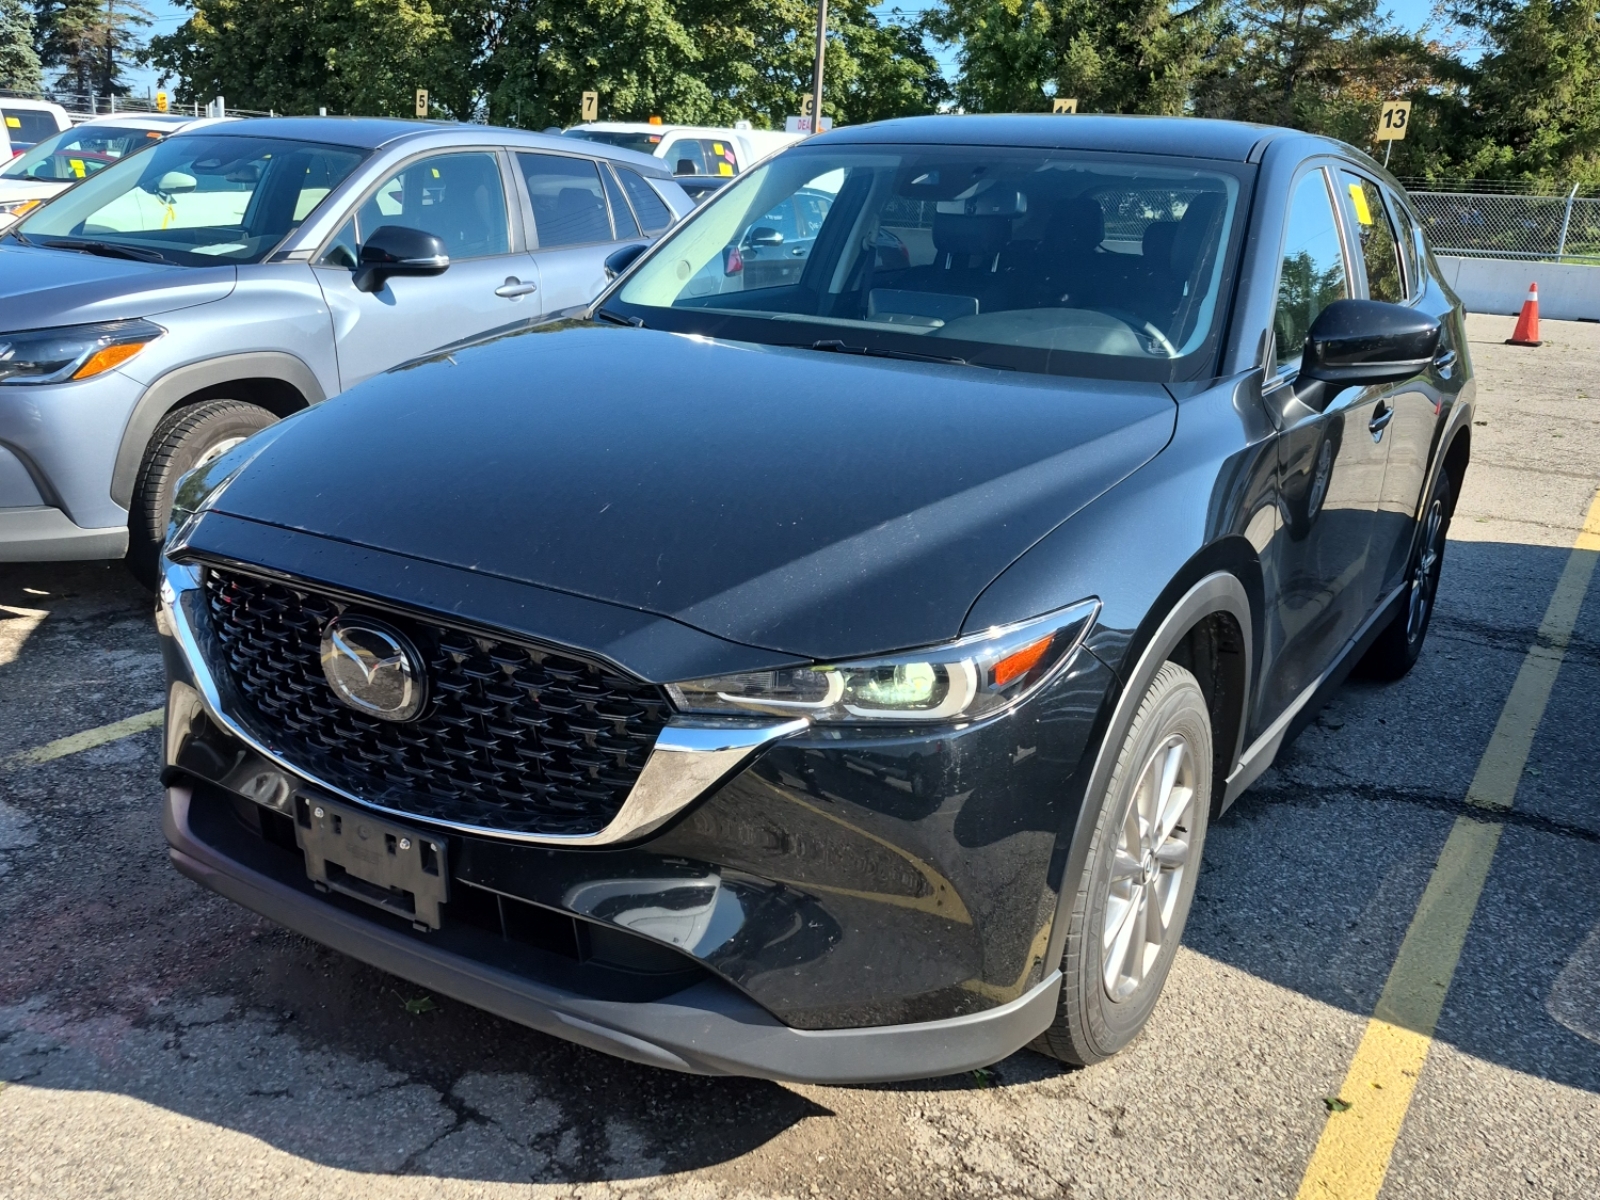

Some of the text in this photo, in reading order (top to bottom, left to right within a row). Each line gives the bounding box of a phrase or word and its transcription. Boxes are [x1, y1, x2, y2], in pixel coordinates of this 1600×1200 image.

[418, 94, 426, 109] 5
[586, 96, 595, 112] 7
[805, 100, 814, 116] 9
[1383, 108, 1407, 129] 13
